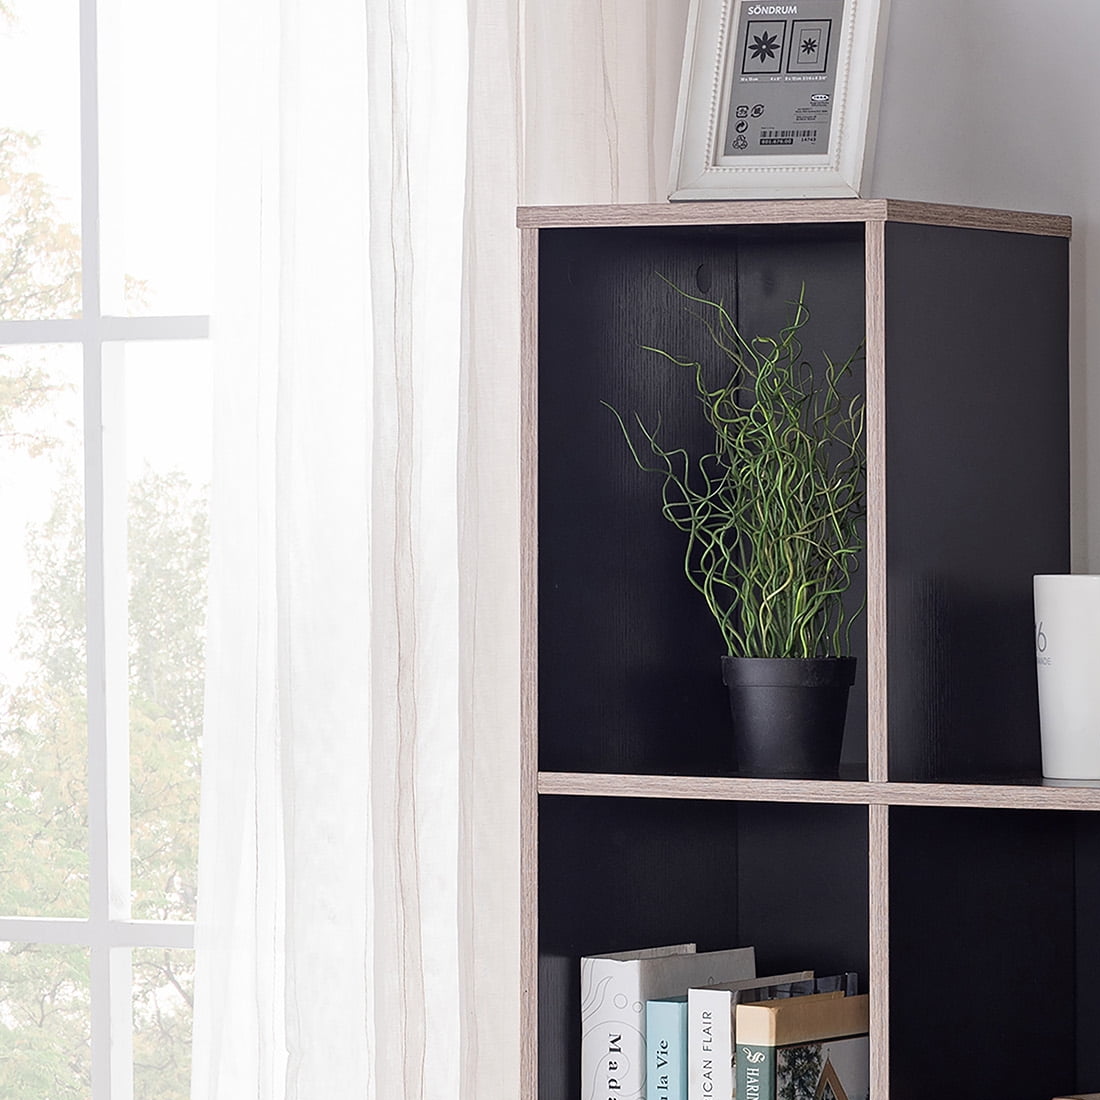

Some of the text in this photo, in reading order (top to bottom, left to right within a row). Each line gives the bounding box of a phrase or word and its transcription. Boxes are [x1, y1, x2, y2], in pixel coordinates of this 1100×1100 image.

[747, 4, 797, 15] SÖNDRUM
[702, 1011, 712, 1052] FLAIR
[656, 1039, 669, 1069] Vie
[657, 1074, 669, 1091] la
